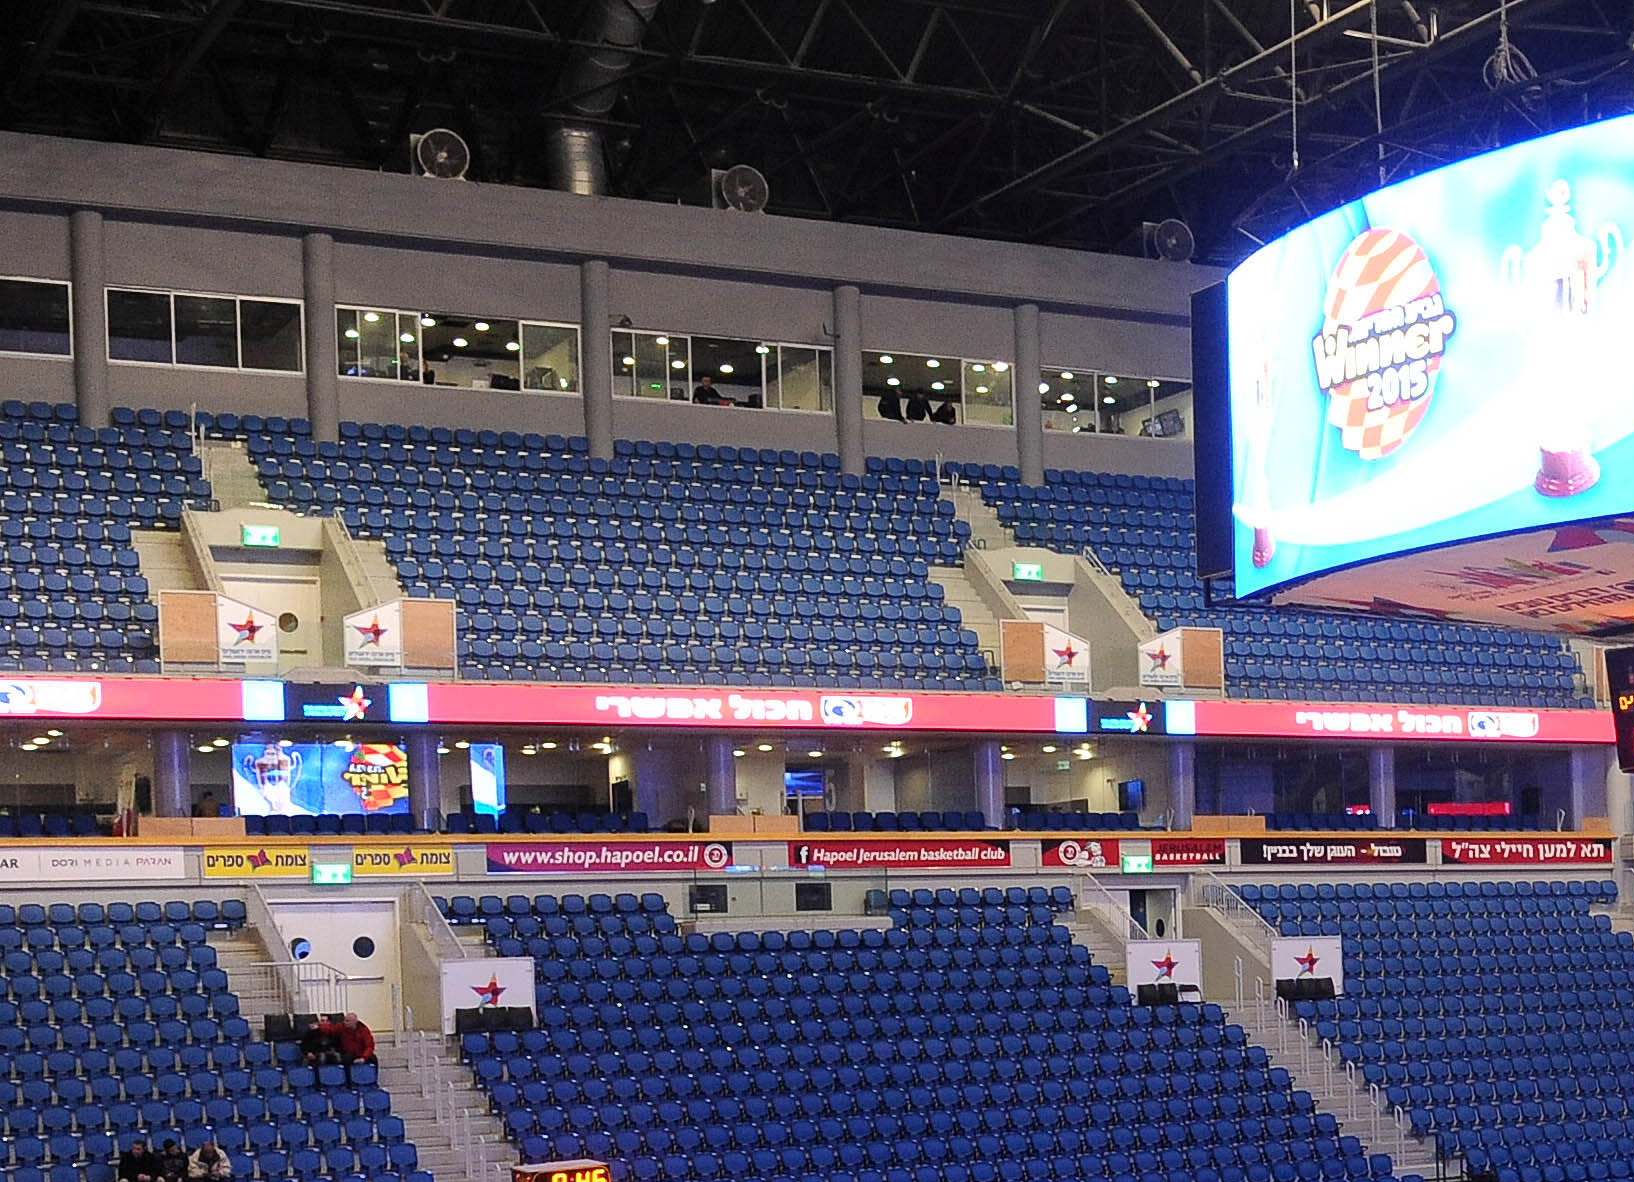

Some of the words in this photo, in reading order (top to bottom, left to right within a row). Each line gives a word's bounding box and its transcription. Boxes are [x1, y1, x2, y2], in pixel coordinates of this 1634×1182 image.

[1313, 311, 1456, 389] Winner
[1367, 358, 1428, 411] 2015
[420, 852, 451, 865] צומת
[503, 845, 698, 868] www.shop.hapoel.co.il
[813, 848, 857, 865] Hapoel
[857, 847, 918, 864] Jerusalem
[920, 847, 979, 861] basketball
[981, 846, 1006, 860] club
[1154, 853, 1221, 861] BASKETBALL
[1299, 842, 1325, 861] שלך
[1327, 844, 1356, 861] העוגן
[1451, 841, 1491, 859] צה"ל
[1494, 841, 1534, 859] חיילי
[1538, 841, 1577, 861] למען
[1580, 843, 1604, 858] תא
[52, 858, 78, 867] DORI
[136, 857, 172, 866] PARAN
[206, 855, 244, 868] ספרים
[275, 854, 307, 867] צומת
[355, 853, 391, 866] ספרים
